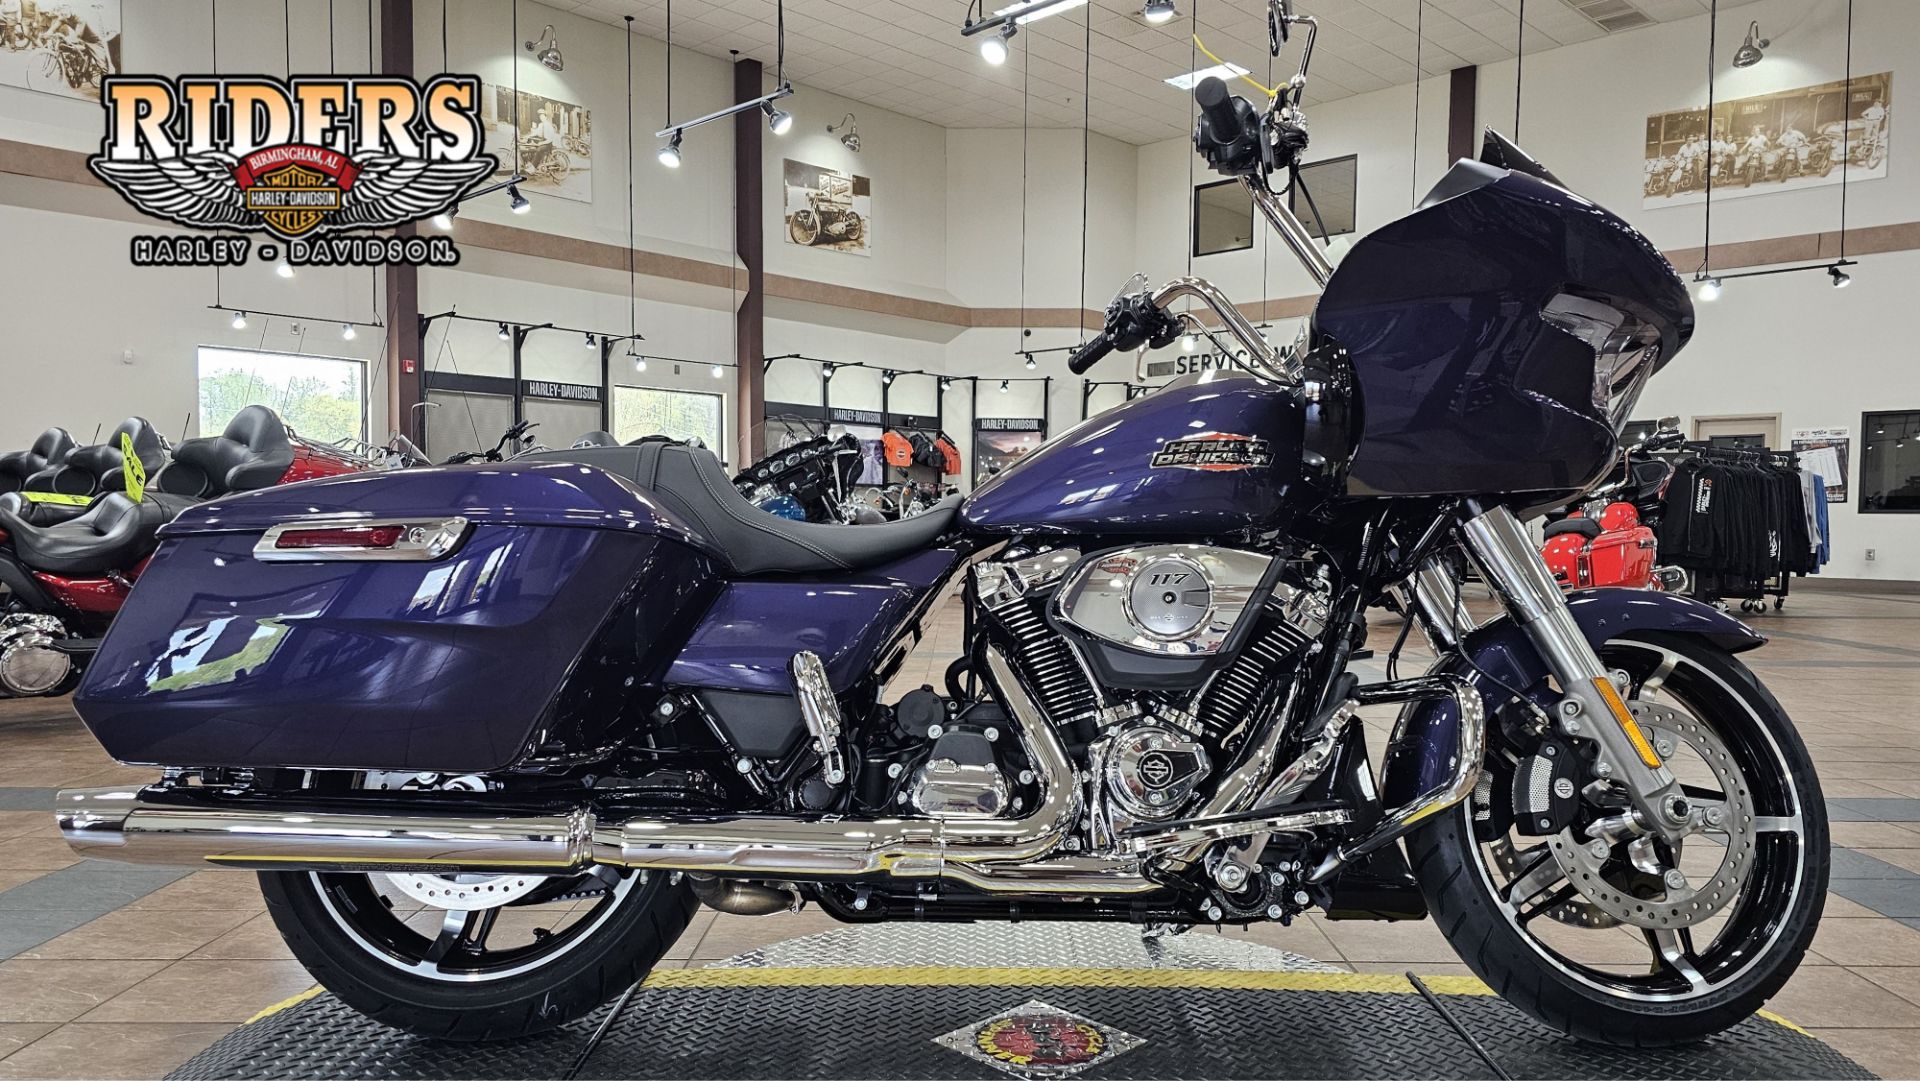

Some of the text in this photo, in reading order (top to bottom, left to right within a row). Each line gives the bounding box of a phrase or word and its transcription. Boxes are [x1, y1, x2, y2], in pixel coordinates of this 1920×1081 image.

[1176, 349, 1260, 375] SERVICE
[529, 382, 598, 400] HARLEY-DAVIDSON
[833, 409, 881, 423] HARLEY-DAVIDSON
[981, 418, 1039, 430] HARLEY-DAVIDSON
[1149, 572, 1191, 586] 117
